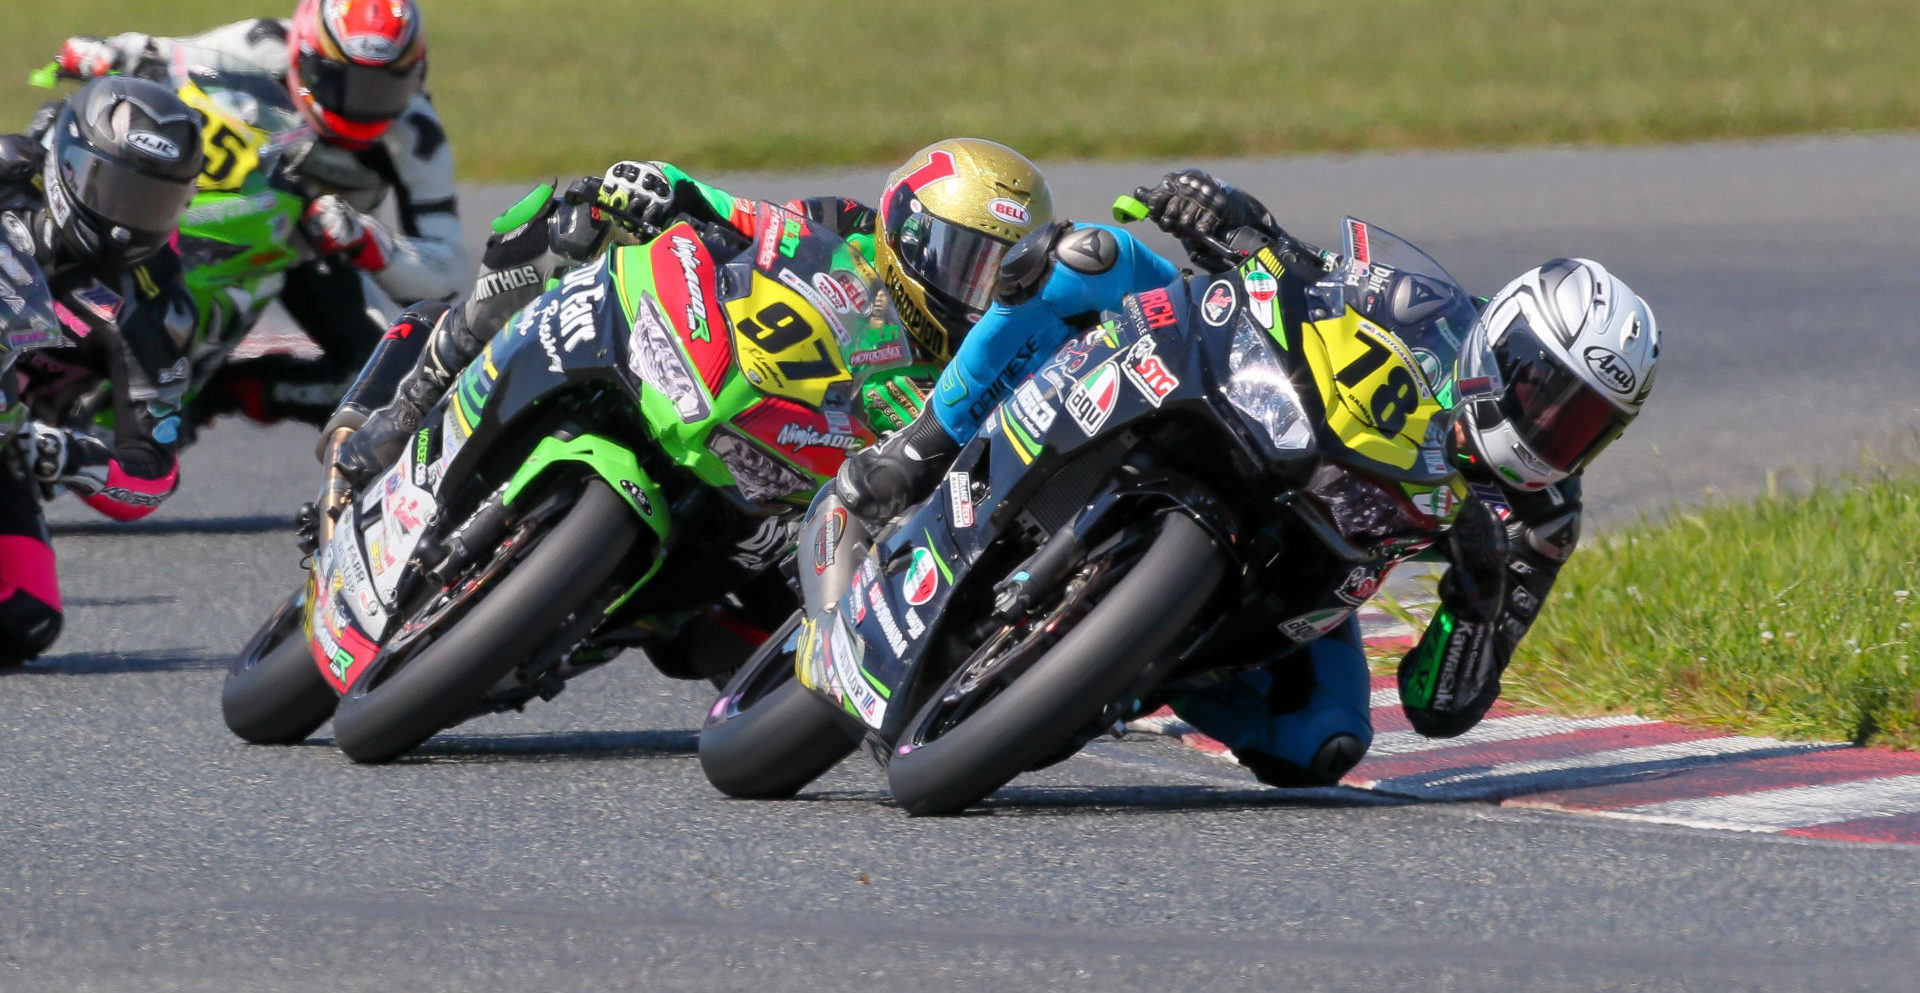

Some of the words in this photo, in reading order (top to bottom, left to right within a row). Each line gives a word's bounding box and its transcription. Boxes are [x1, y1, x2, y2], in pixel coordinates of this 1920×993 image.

[200, 112, 247, 182] 5
[995, 203, 1026, 221] BELL
[837, 274, 867, 312] BELL
[736, 301, 842, 381] 97
[1375, 330, 1425, 394] MOTOAMERICA
[1586, 354, 1632, 388] Arai
[968, 333, 1040, 422] DAINESE
[1134, 356, 1177, 397] STG
[1333, 328, 1420, 439] 78
[1433, 620, 1474, 712] Kawasaki
